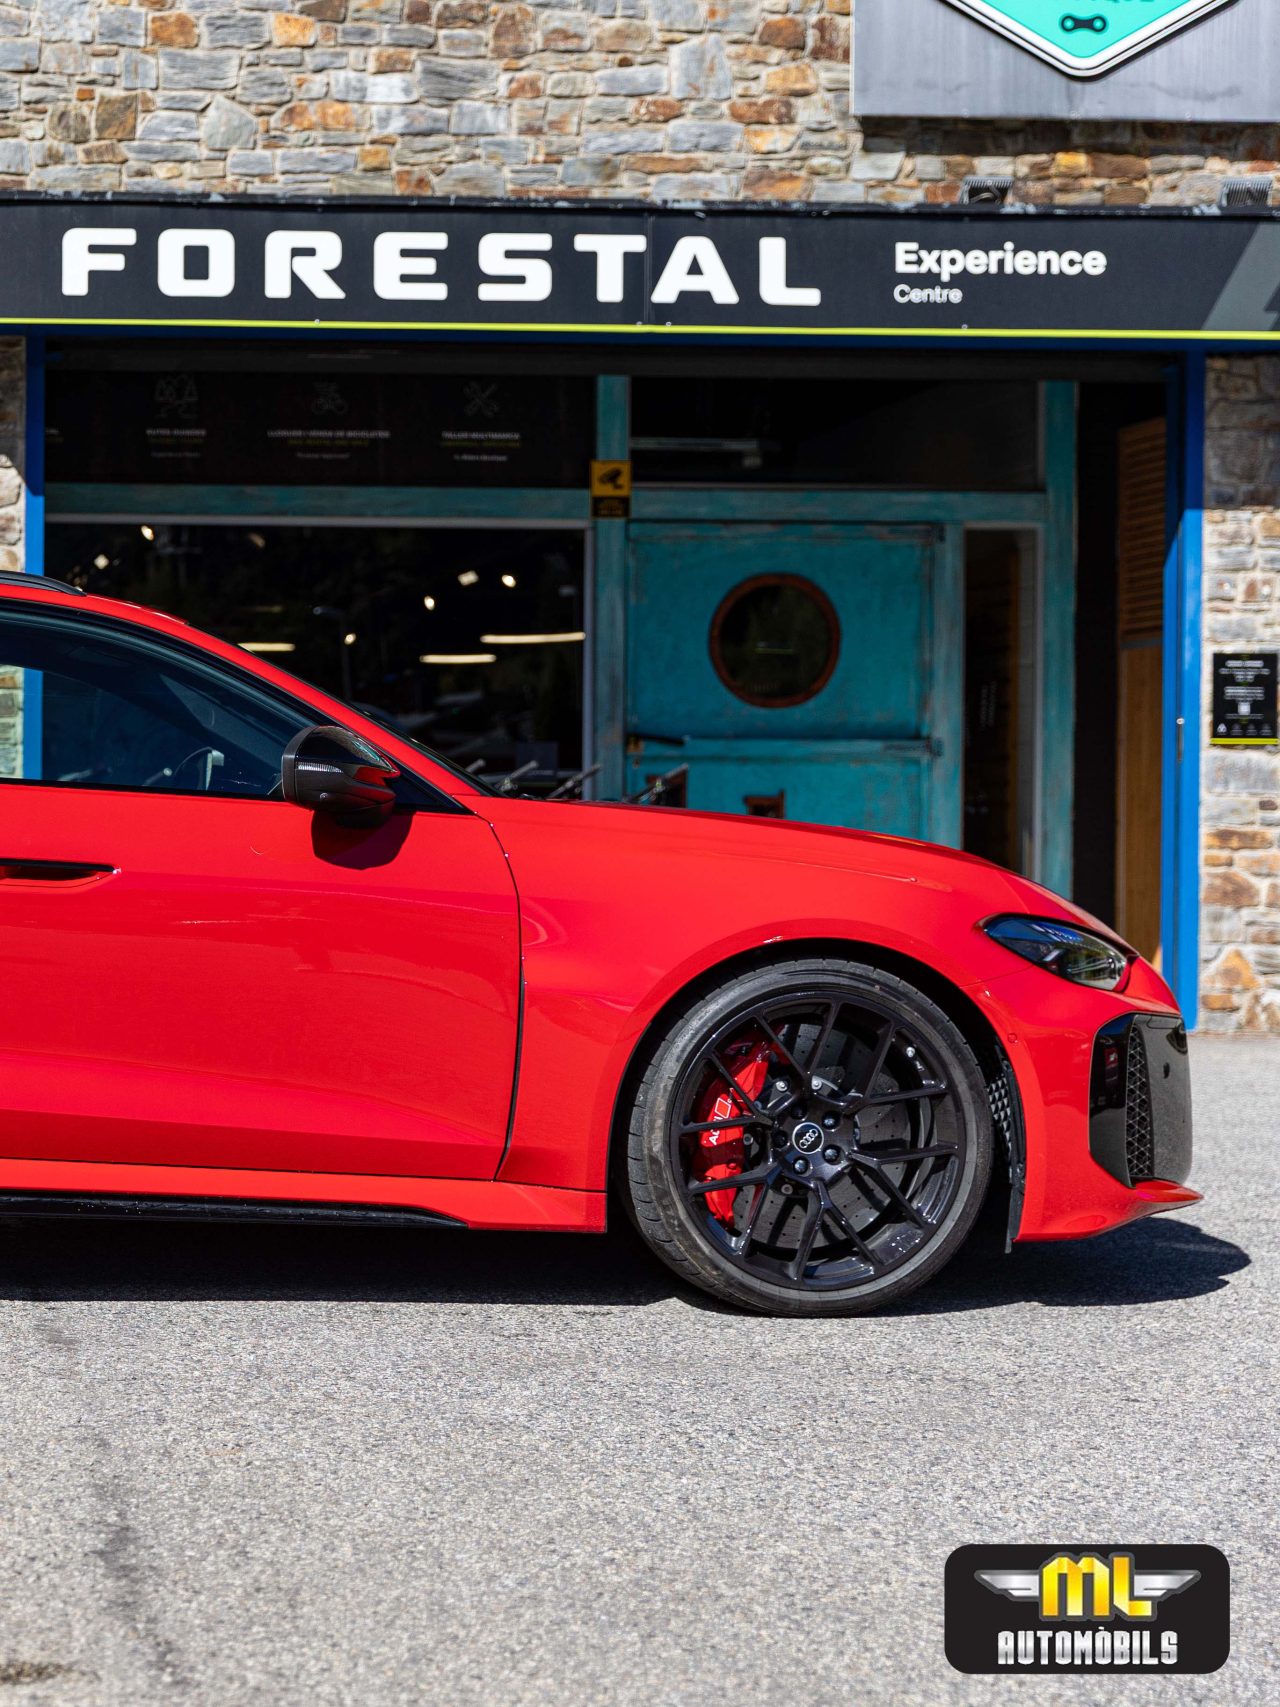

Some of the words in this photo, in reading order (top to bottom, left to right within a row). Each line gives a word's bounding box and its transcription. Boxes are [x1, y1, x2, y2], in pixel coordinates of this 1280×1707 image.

[61, 227, 821, 306] FORESTAL
[895, 241, 1108, 283] Experience
[893, 283, 963, 304] Centre
